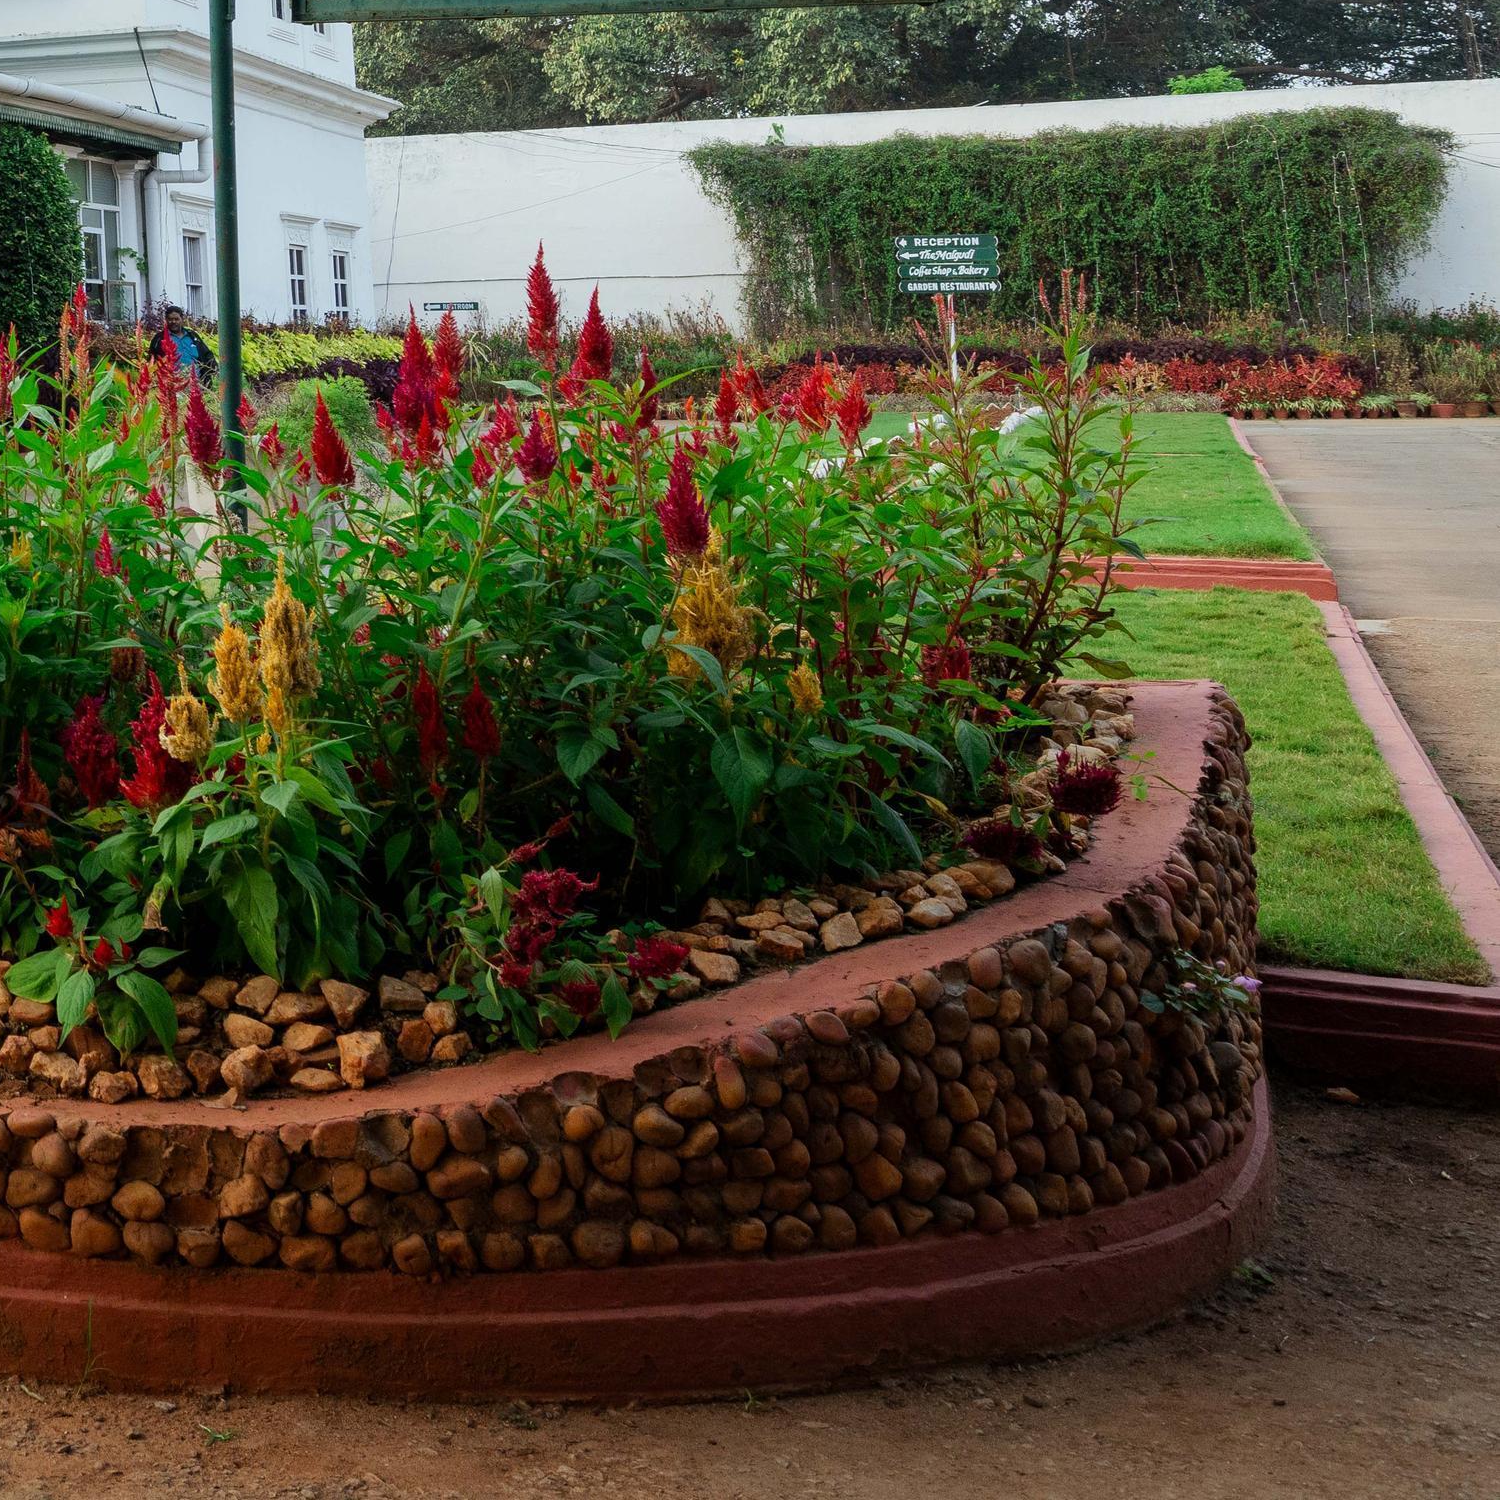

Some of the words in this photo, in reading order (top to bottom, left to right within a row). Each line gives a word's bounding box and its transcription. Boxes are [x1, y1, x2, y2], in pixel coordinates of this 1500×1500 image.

[914, 237, 979, 247] RECEPTION
[909, 265, 931, 277] Coffee
[932, 266, 951, 276] Shop
[958, 265, 989, 276] Bakery
[907, 282, 938, 291] GARDEN
[941, 282, 990, 291] RESTAURANT
